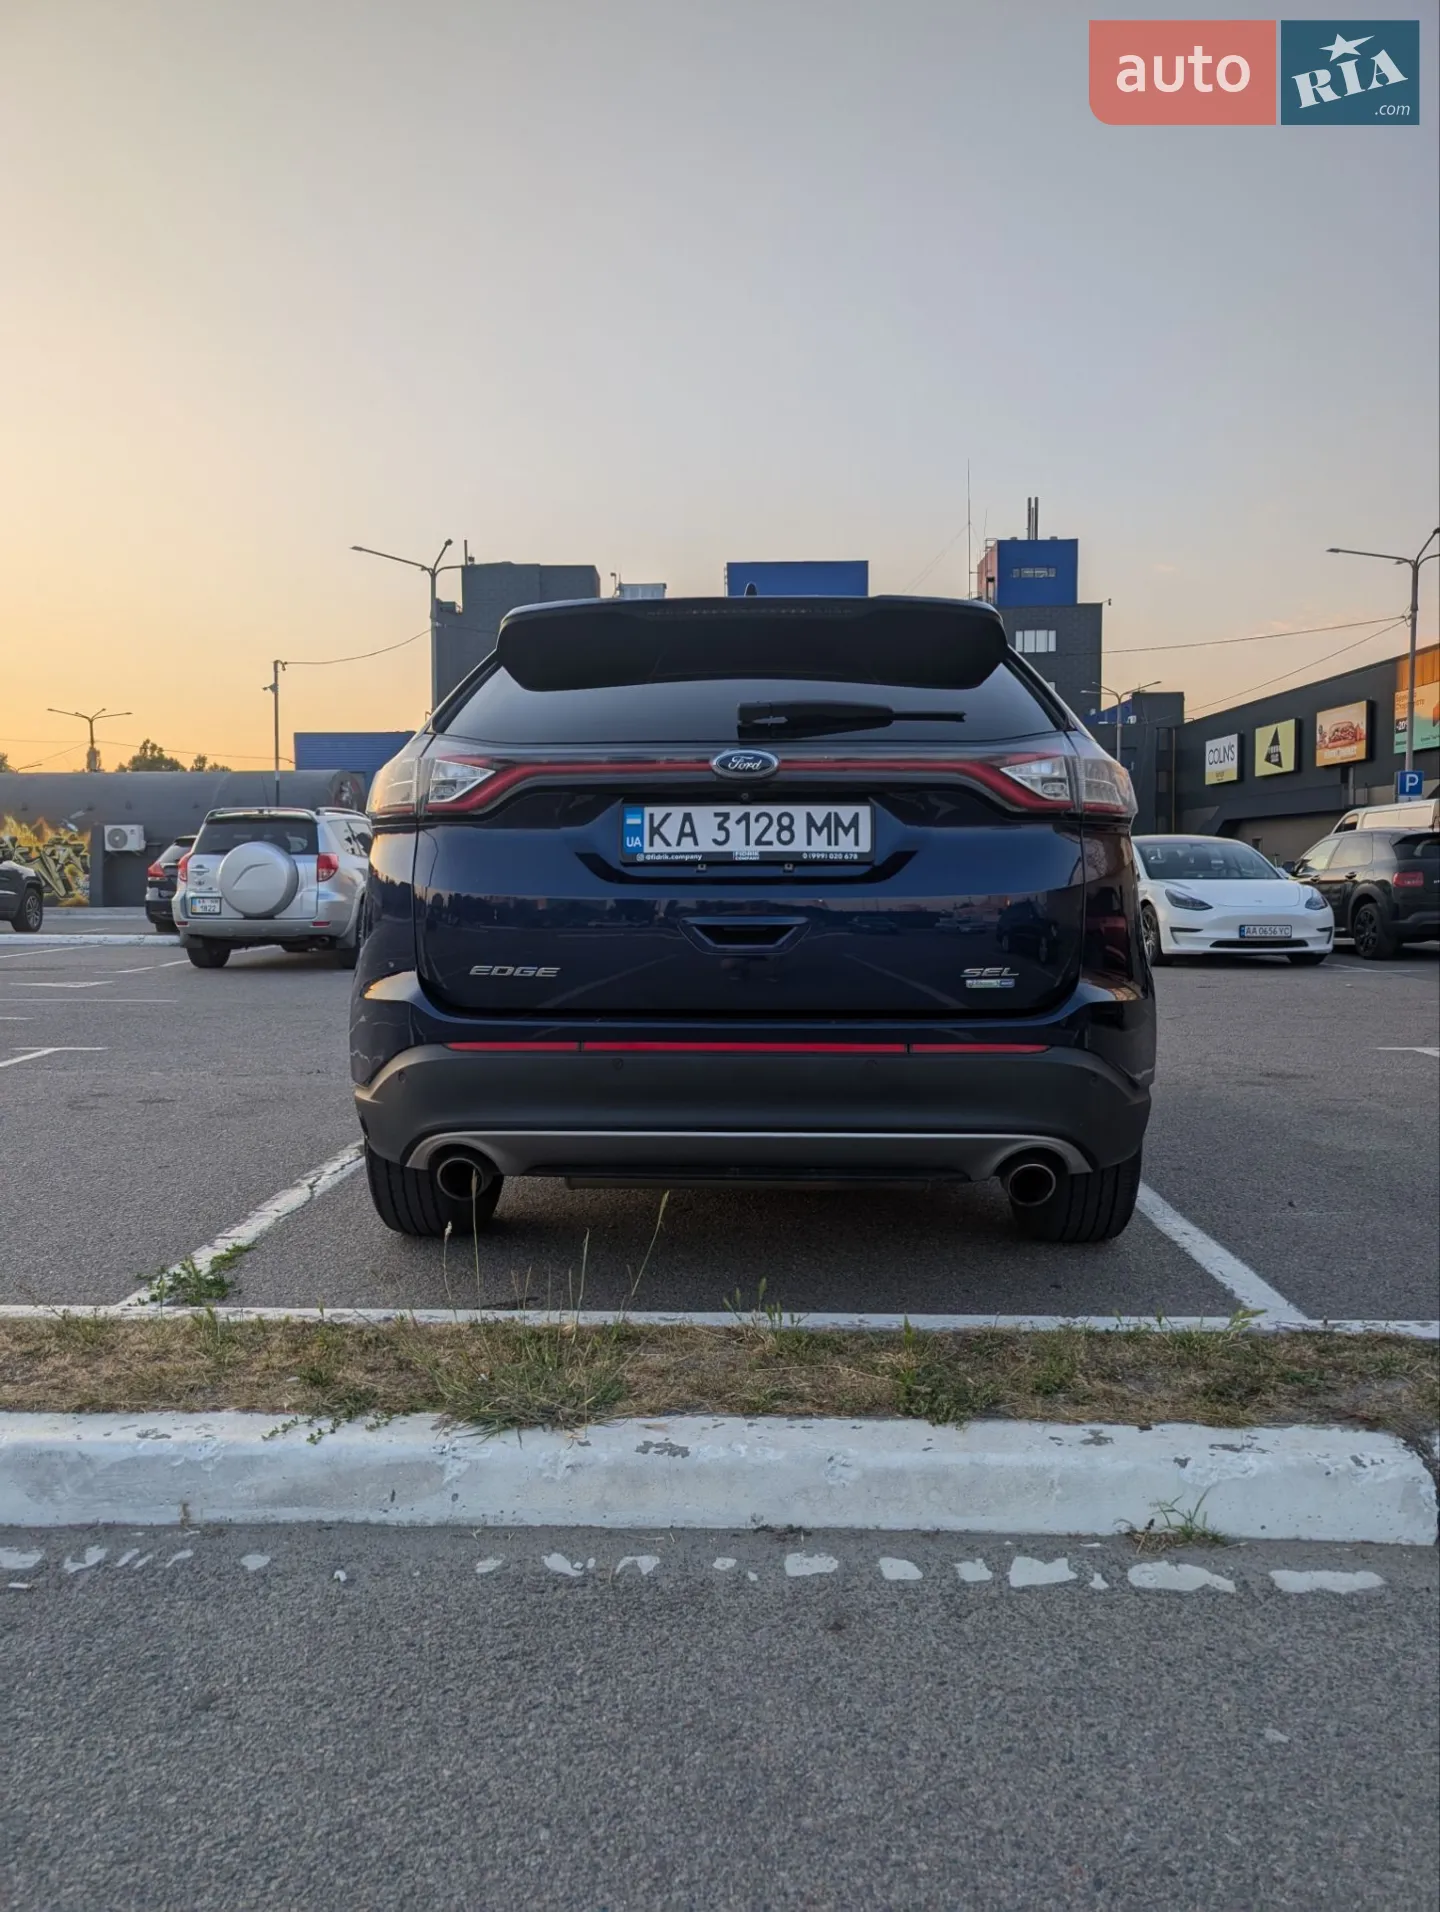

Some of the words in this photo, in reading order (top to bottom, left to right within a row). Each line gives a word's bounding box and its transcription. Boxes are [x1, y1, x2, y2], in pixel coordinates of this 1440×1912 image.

[1207, 740, 1235, 766] COLIN'S
[727, 755, 762, 770] Ford
[1405, 773, 1419, 793] P
[648, 812, 699, 848] KA
[711, 811, 796, 847] 3128
[805, 811, 860, 847] MM
[626, 836, 642, 848] UA
[645, 853, 703, 861] @fidrik.company
[1246, 926, 1258, 936] AA
[469, 965, 561, 978] EDGE
[959, 967, 1020, 978] SEL
